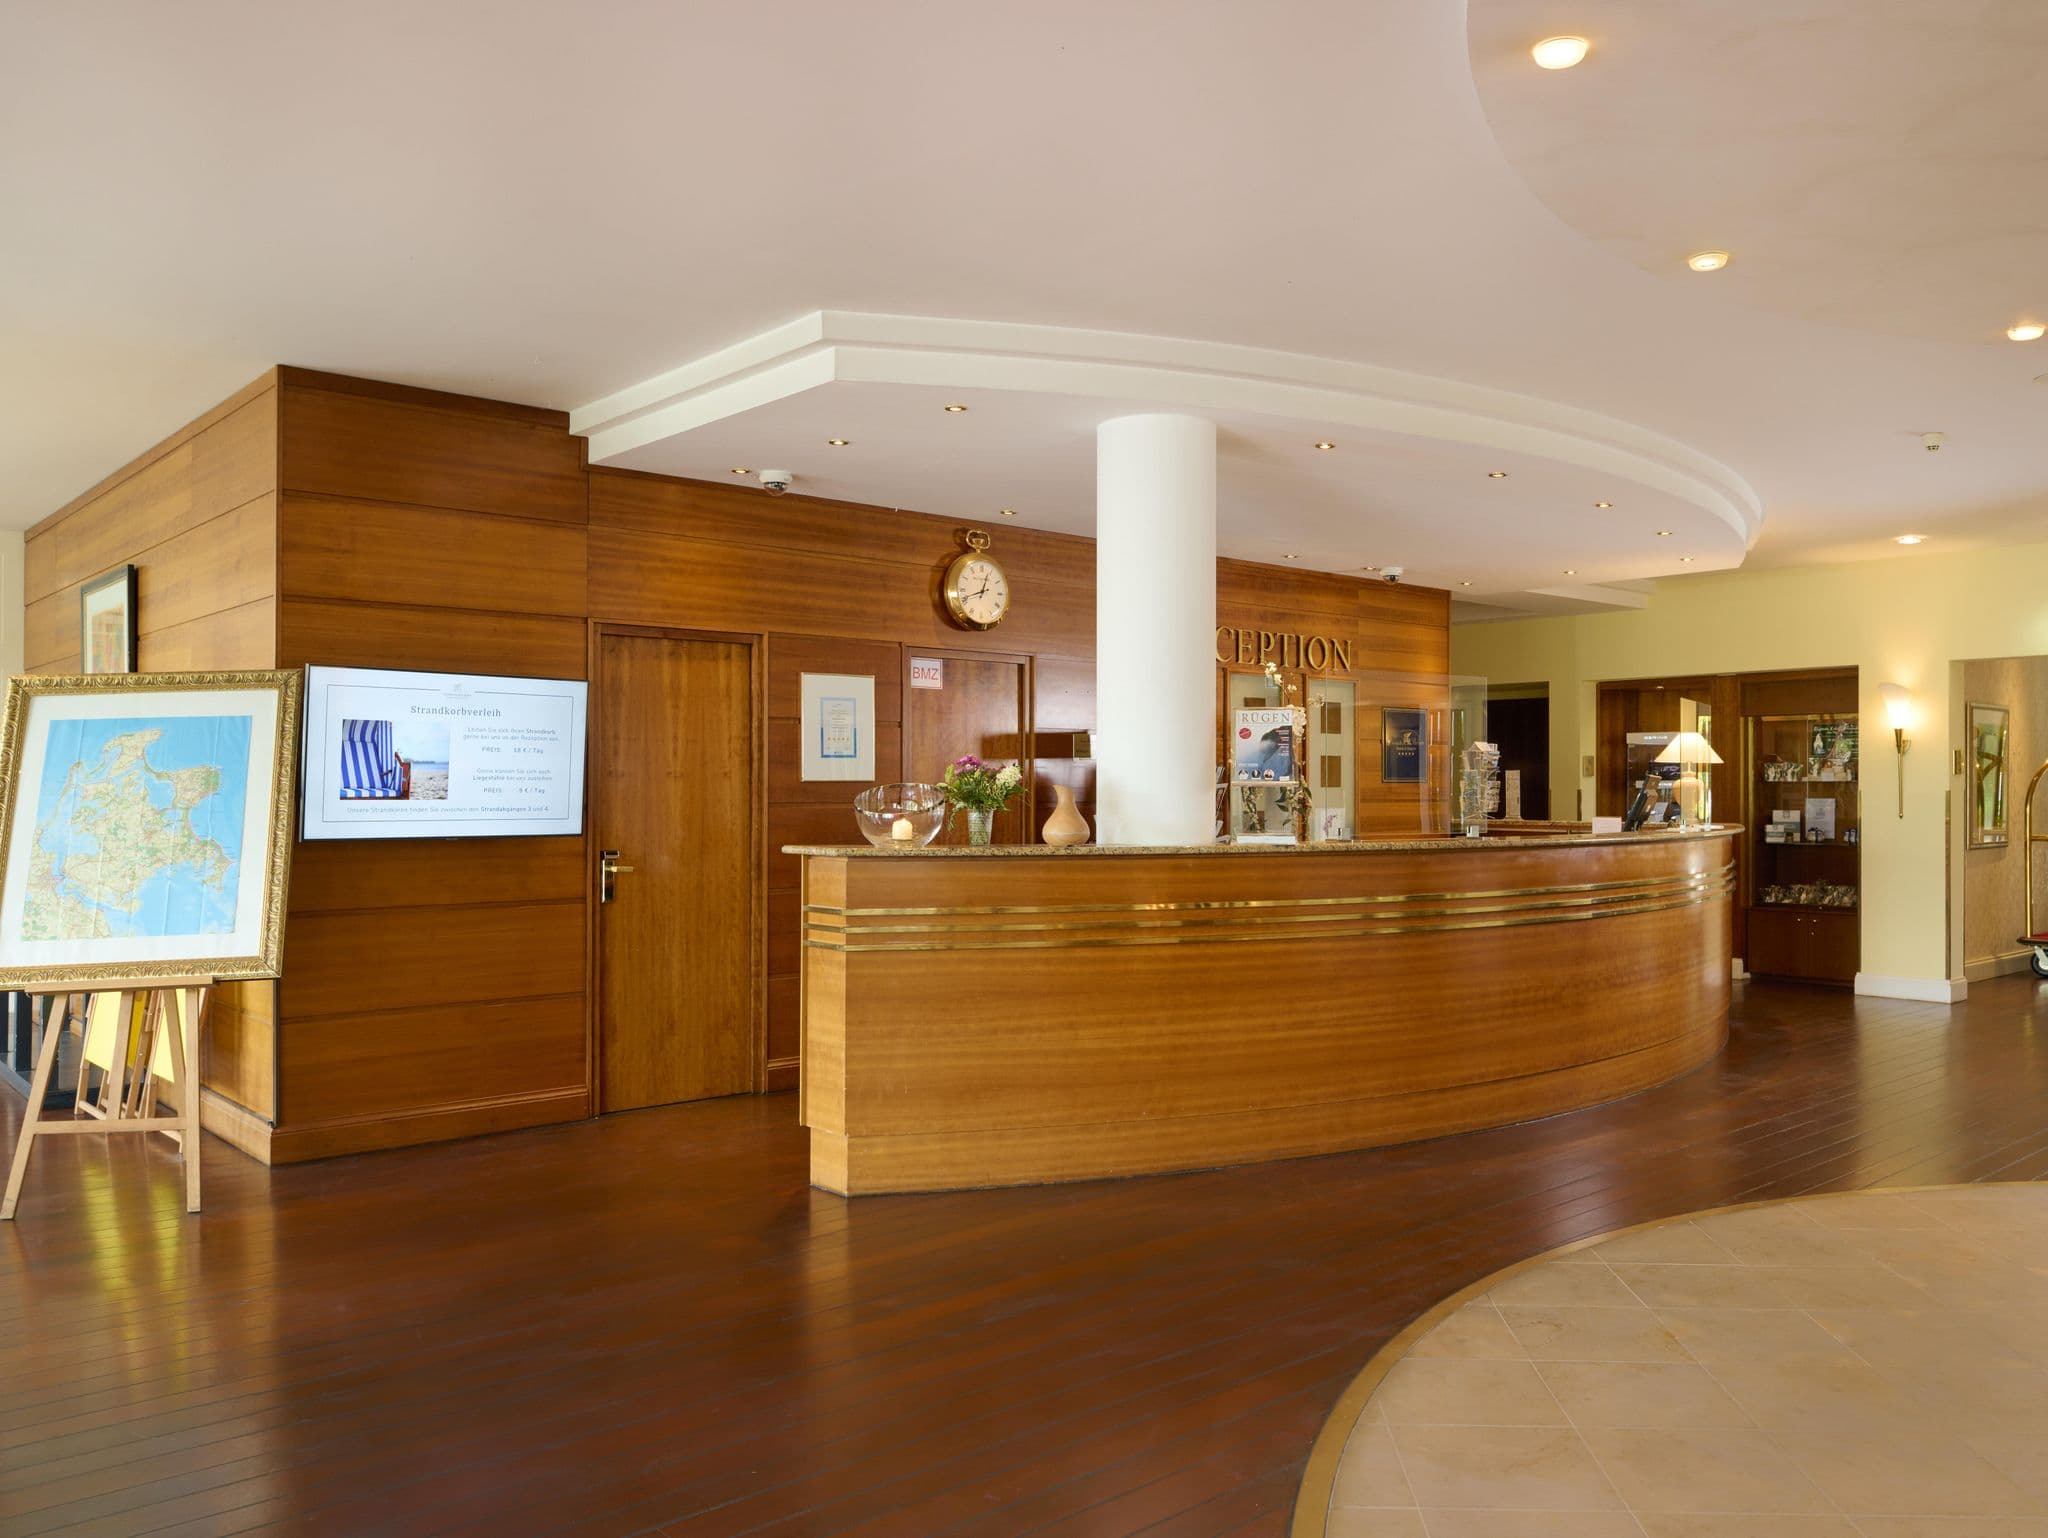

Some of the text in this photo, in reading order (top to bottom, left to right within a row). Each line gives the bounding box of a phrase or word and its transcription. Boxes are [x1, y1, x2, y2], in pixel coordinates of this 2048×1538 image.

[913, 666, 939, 681] BMZ
[410, 705, 501, 717] Strandkorbverleih
[1241, 711, 1290, 723] RÜGEN
